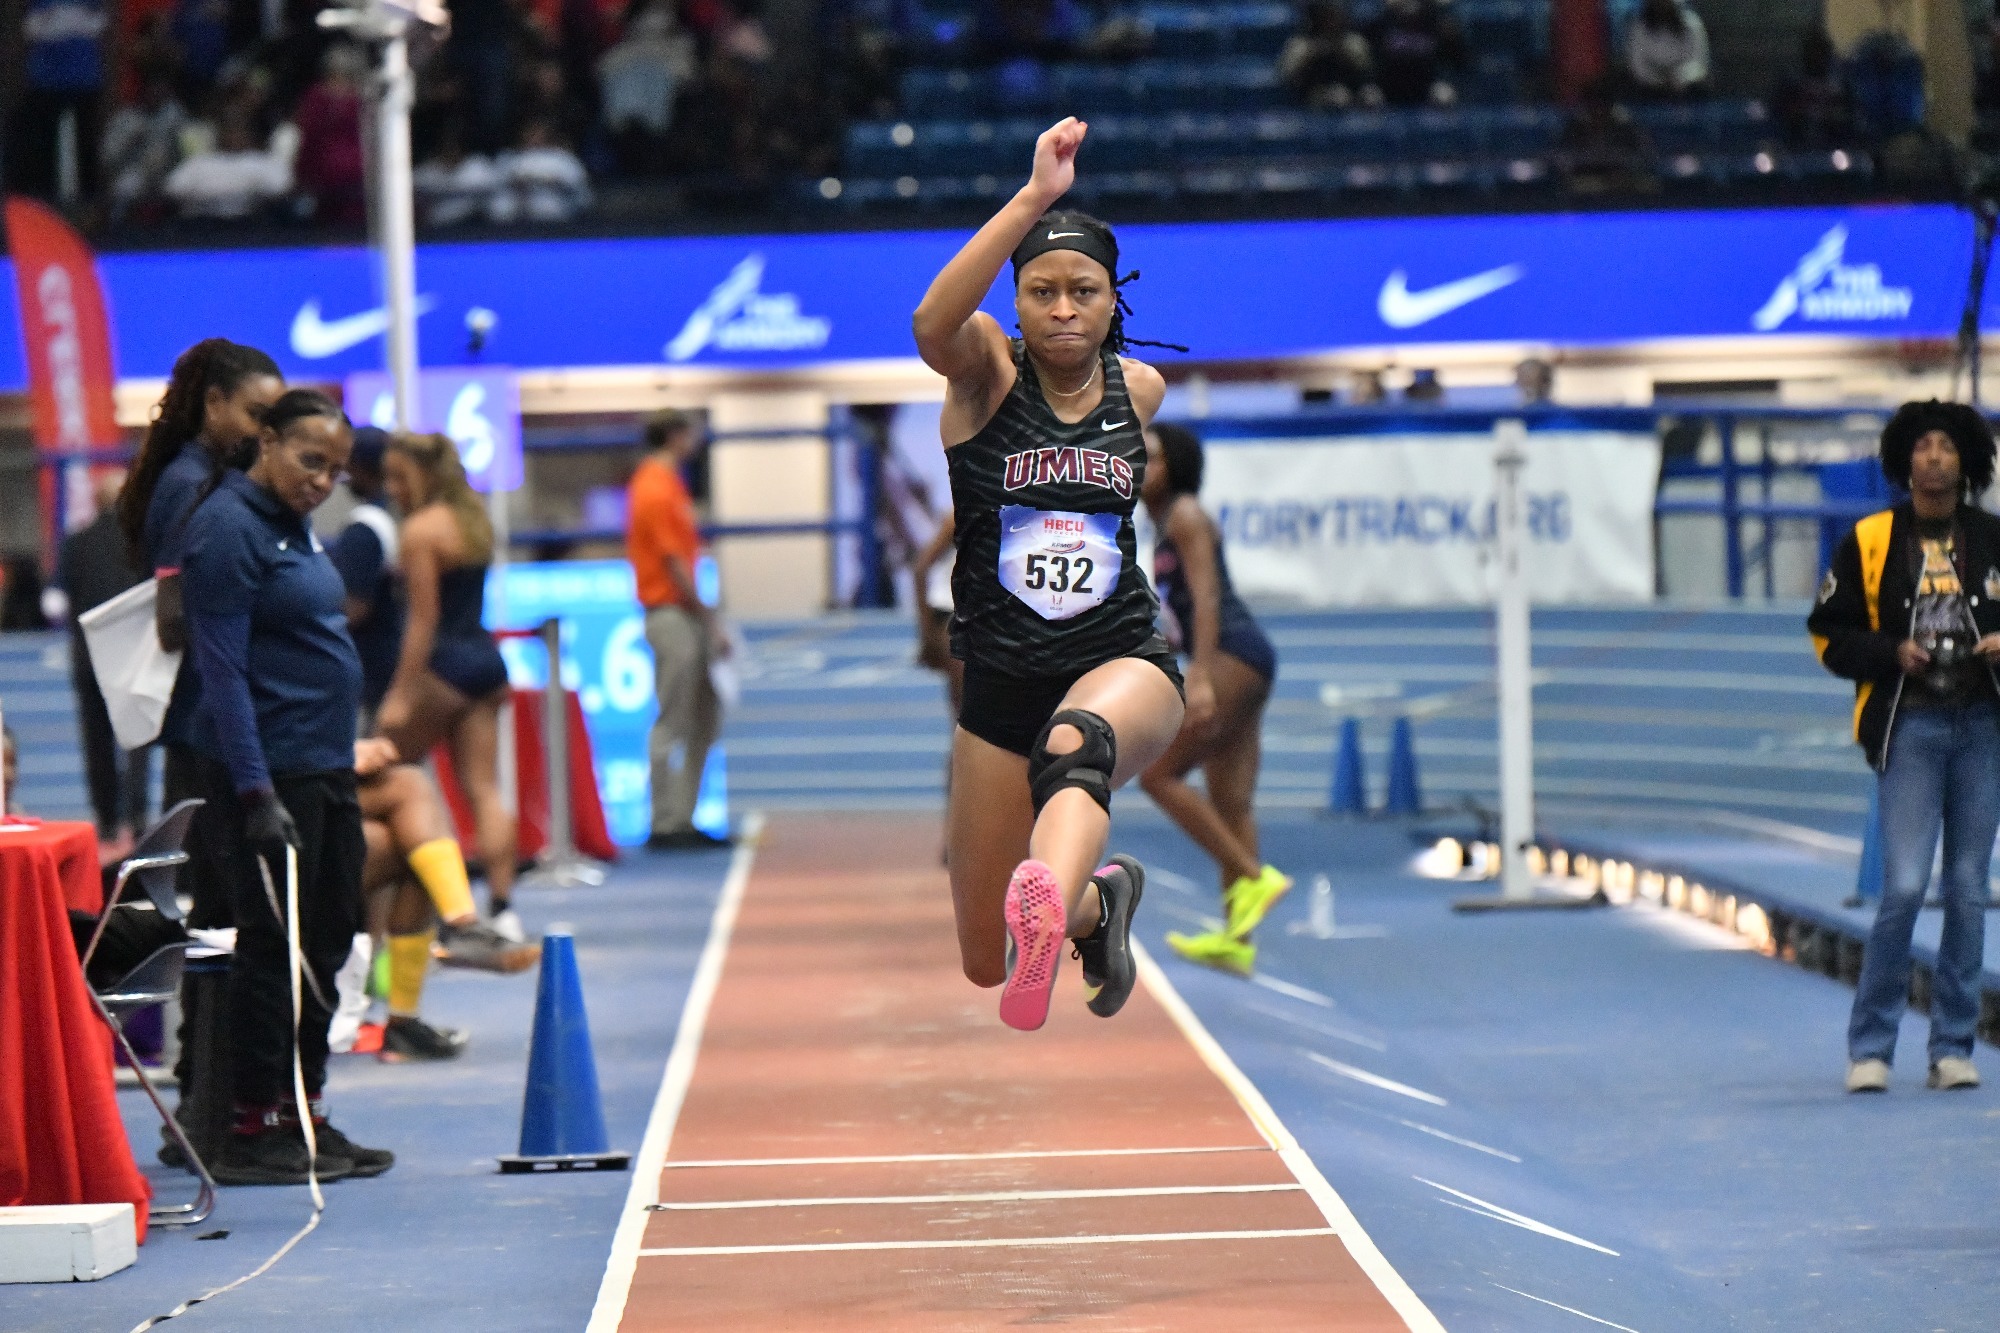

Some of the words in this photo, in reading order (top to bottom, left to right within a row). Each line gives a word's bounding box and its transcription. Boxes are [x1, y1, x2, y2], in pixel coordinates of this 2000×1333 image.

[1004, 447, 1133, 500] UMES
[1044, 519, 1084, 532] HBCU
[1025, 554, 1094, 593] 532
